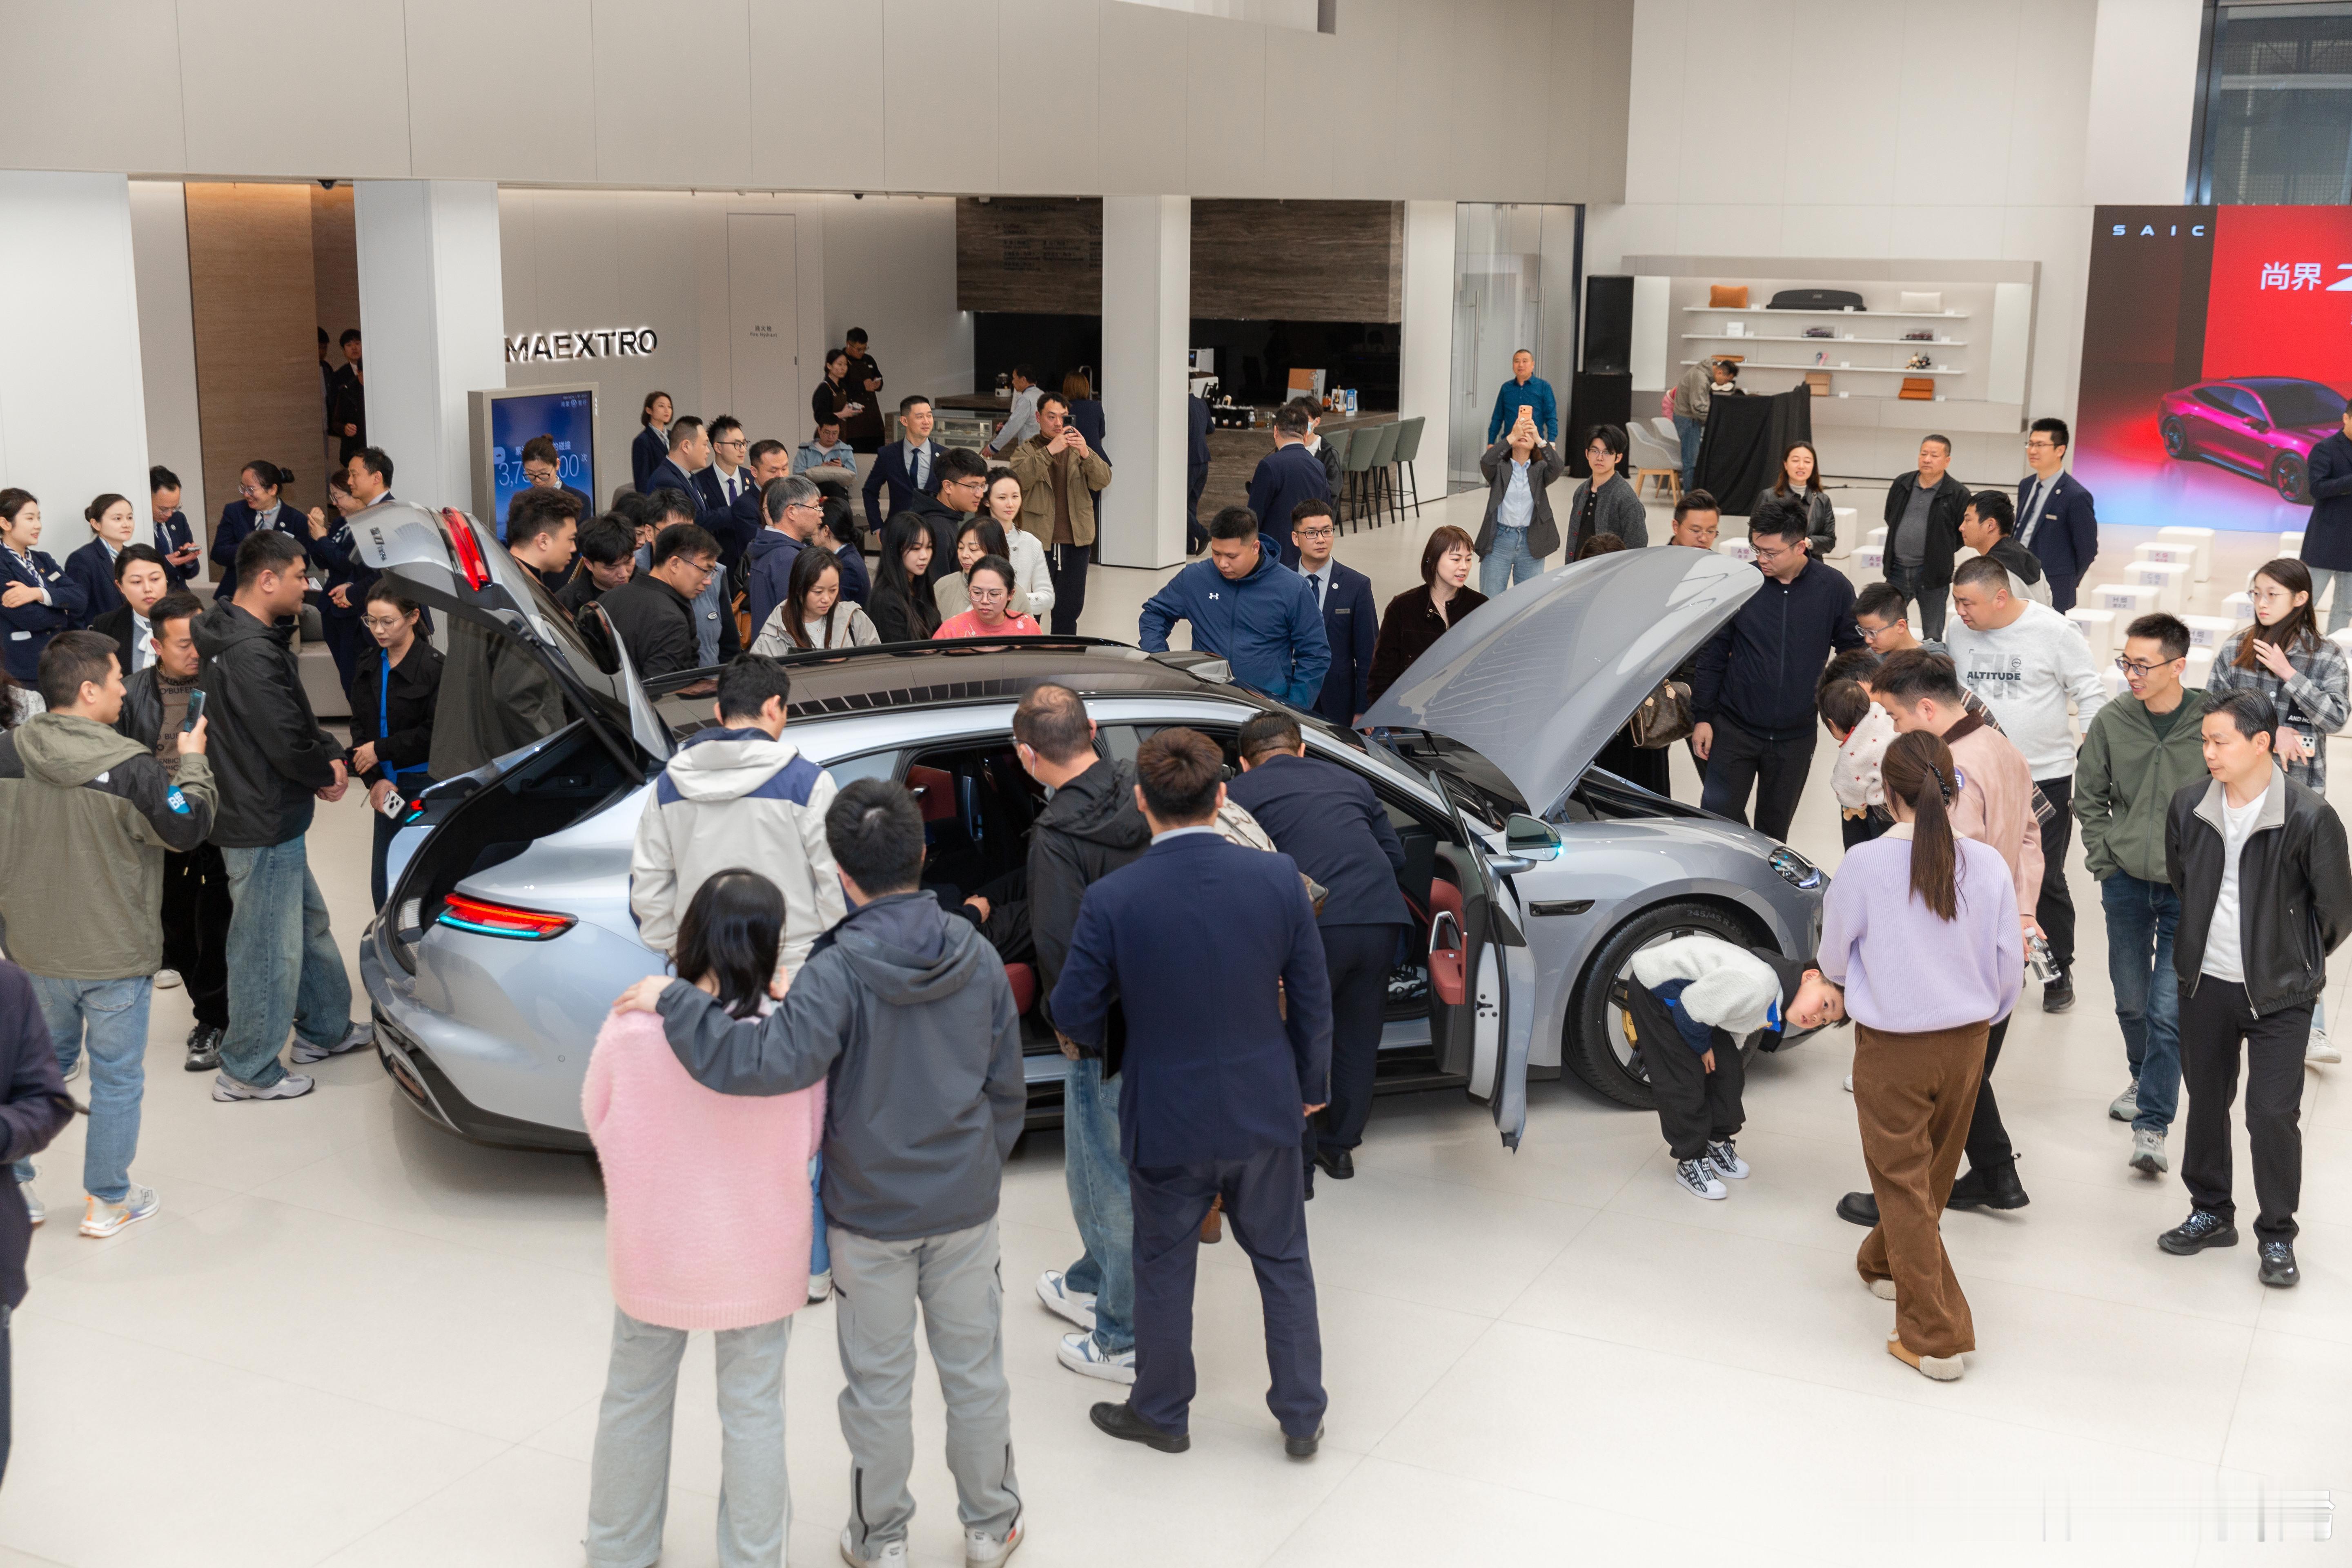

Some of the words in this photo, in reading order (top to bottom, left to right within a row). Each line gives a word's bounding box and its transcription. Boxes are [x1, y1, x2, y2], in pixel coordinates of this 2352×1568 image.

[2112, 225, 2205, 236] SAIC
[2261, 261, 2321, 291] 尚界
[505, 329, 657, 362] MAEXTRO
[1967, 671, 2021, 680] ALTITUDE
[1687, 909, 1722, 922] 245/45
